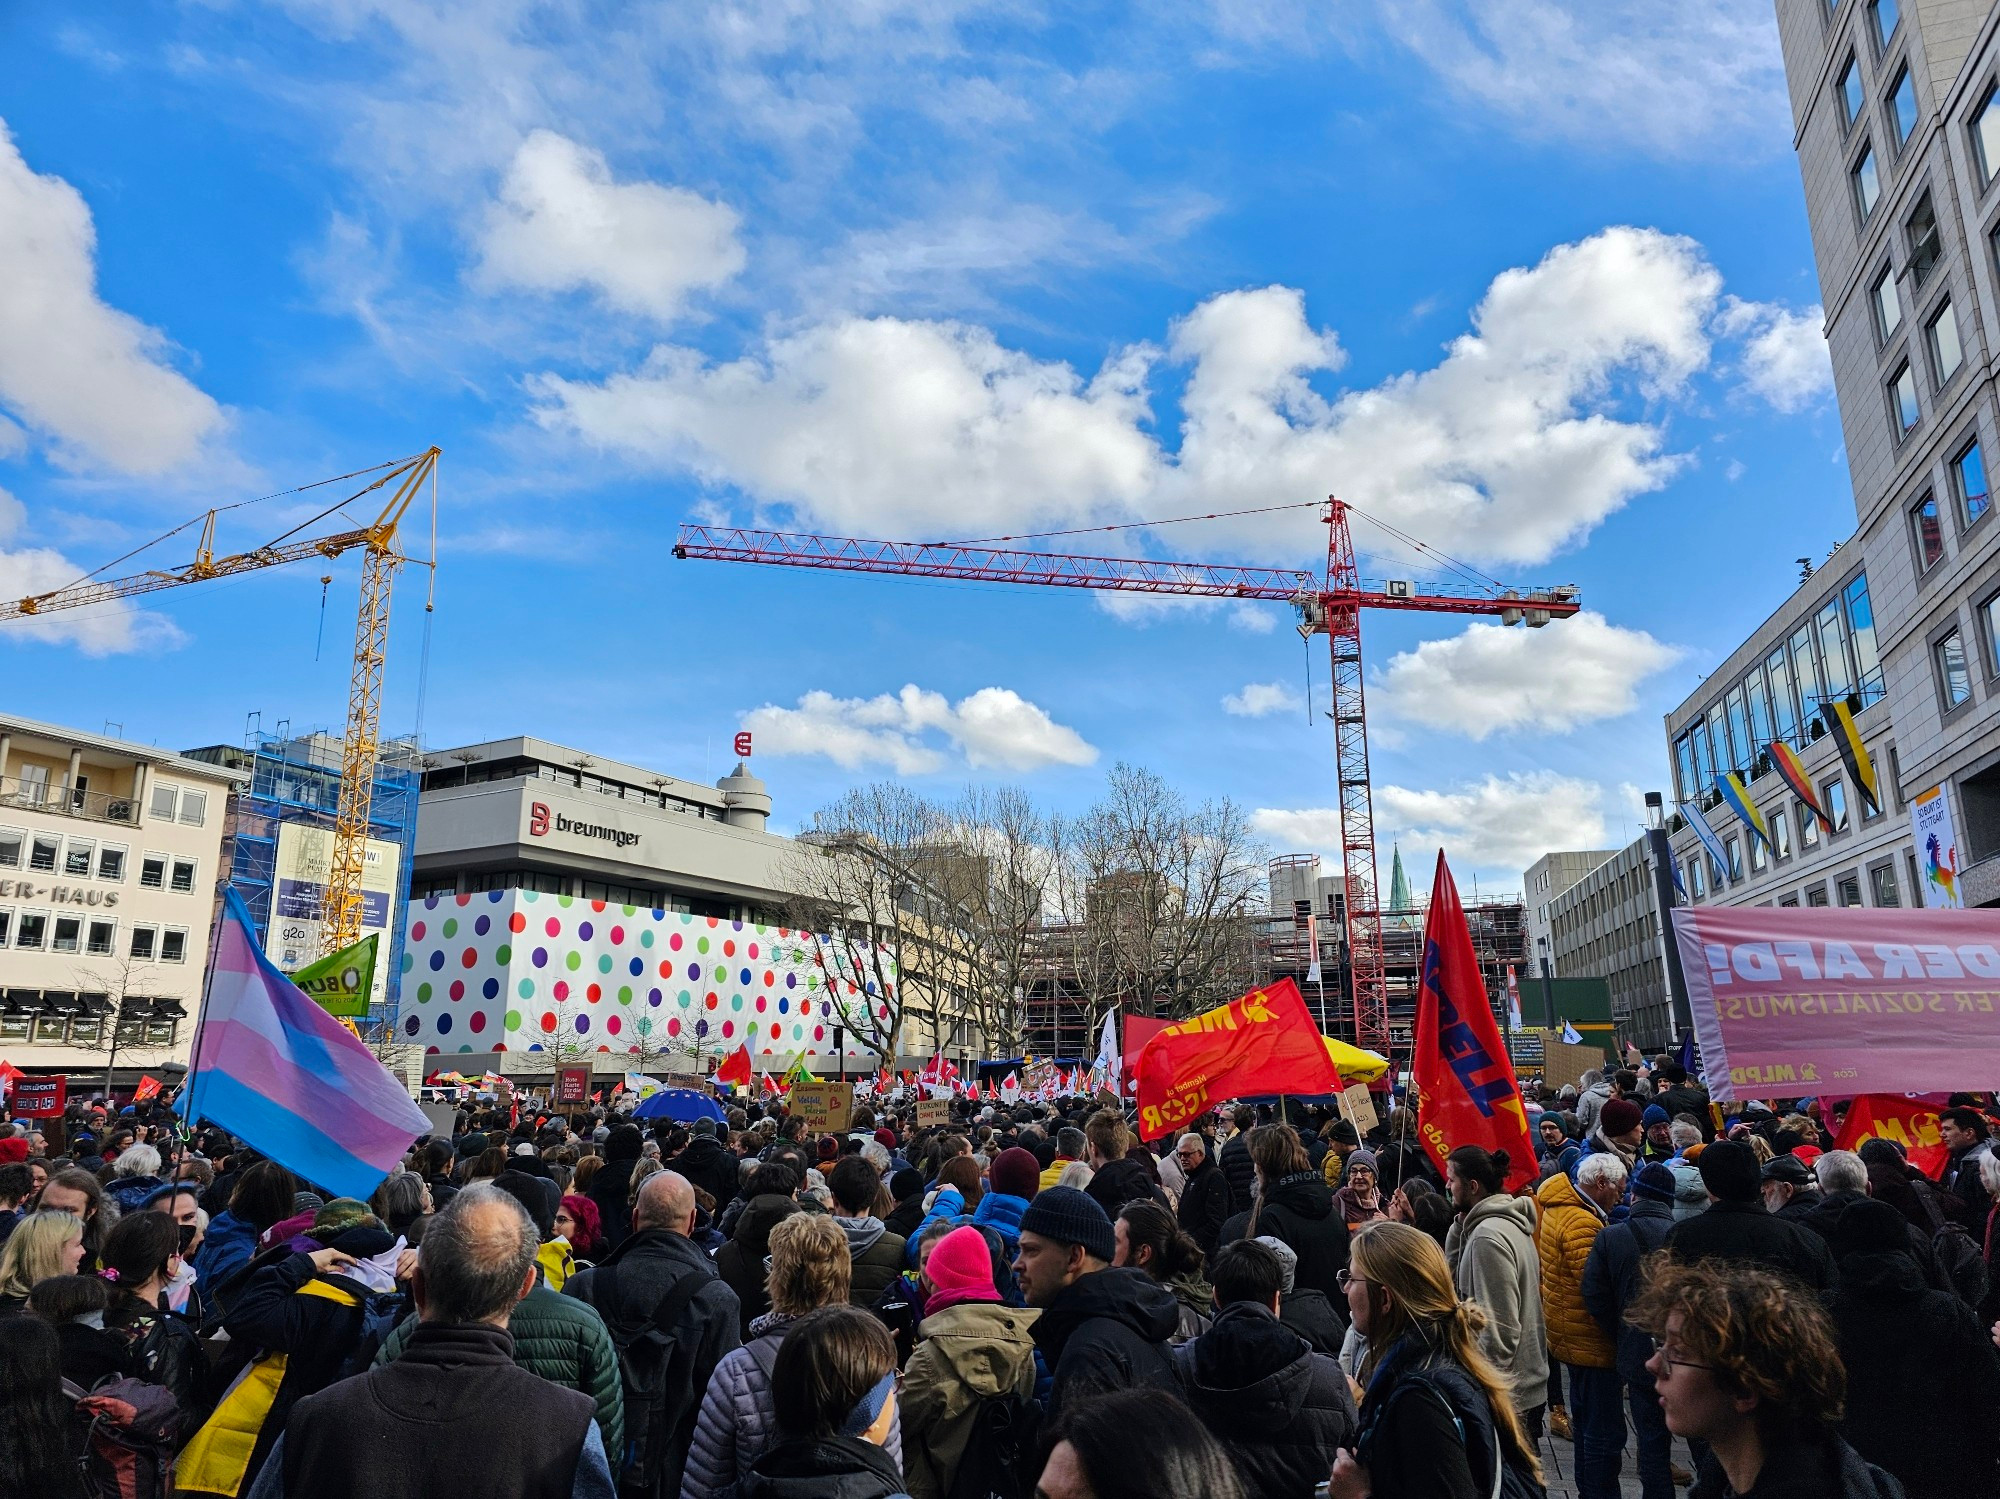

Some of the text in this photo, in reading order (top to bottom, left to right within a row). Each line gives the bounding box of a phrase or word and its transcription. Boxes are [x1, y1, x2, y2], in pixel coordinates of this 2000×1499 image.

[1920, 810, 1944, 831] STUTTGART
[557, 813, 642, 847] breuninger
[283, 927, 305, 940] g2o
[828, 1084, 844, 1093] FÜR
[920, 1101, 946, 1109] ZUKUNFT
[1280, 1170, 1317, 1186] JONES
